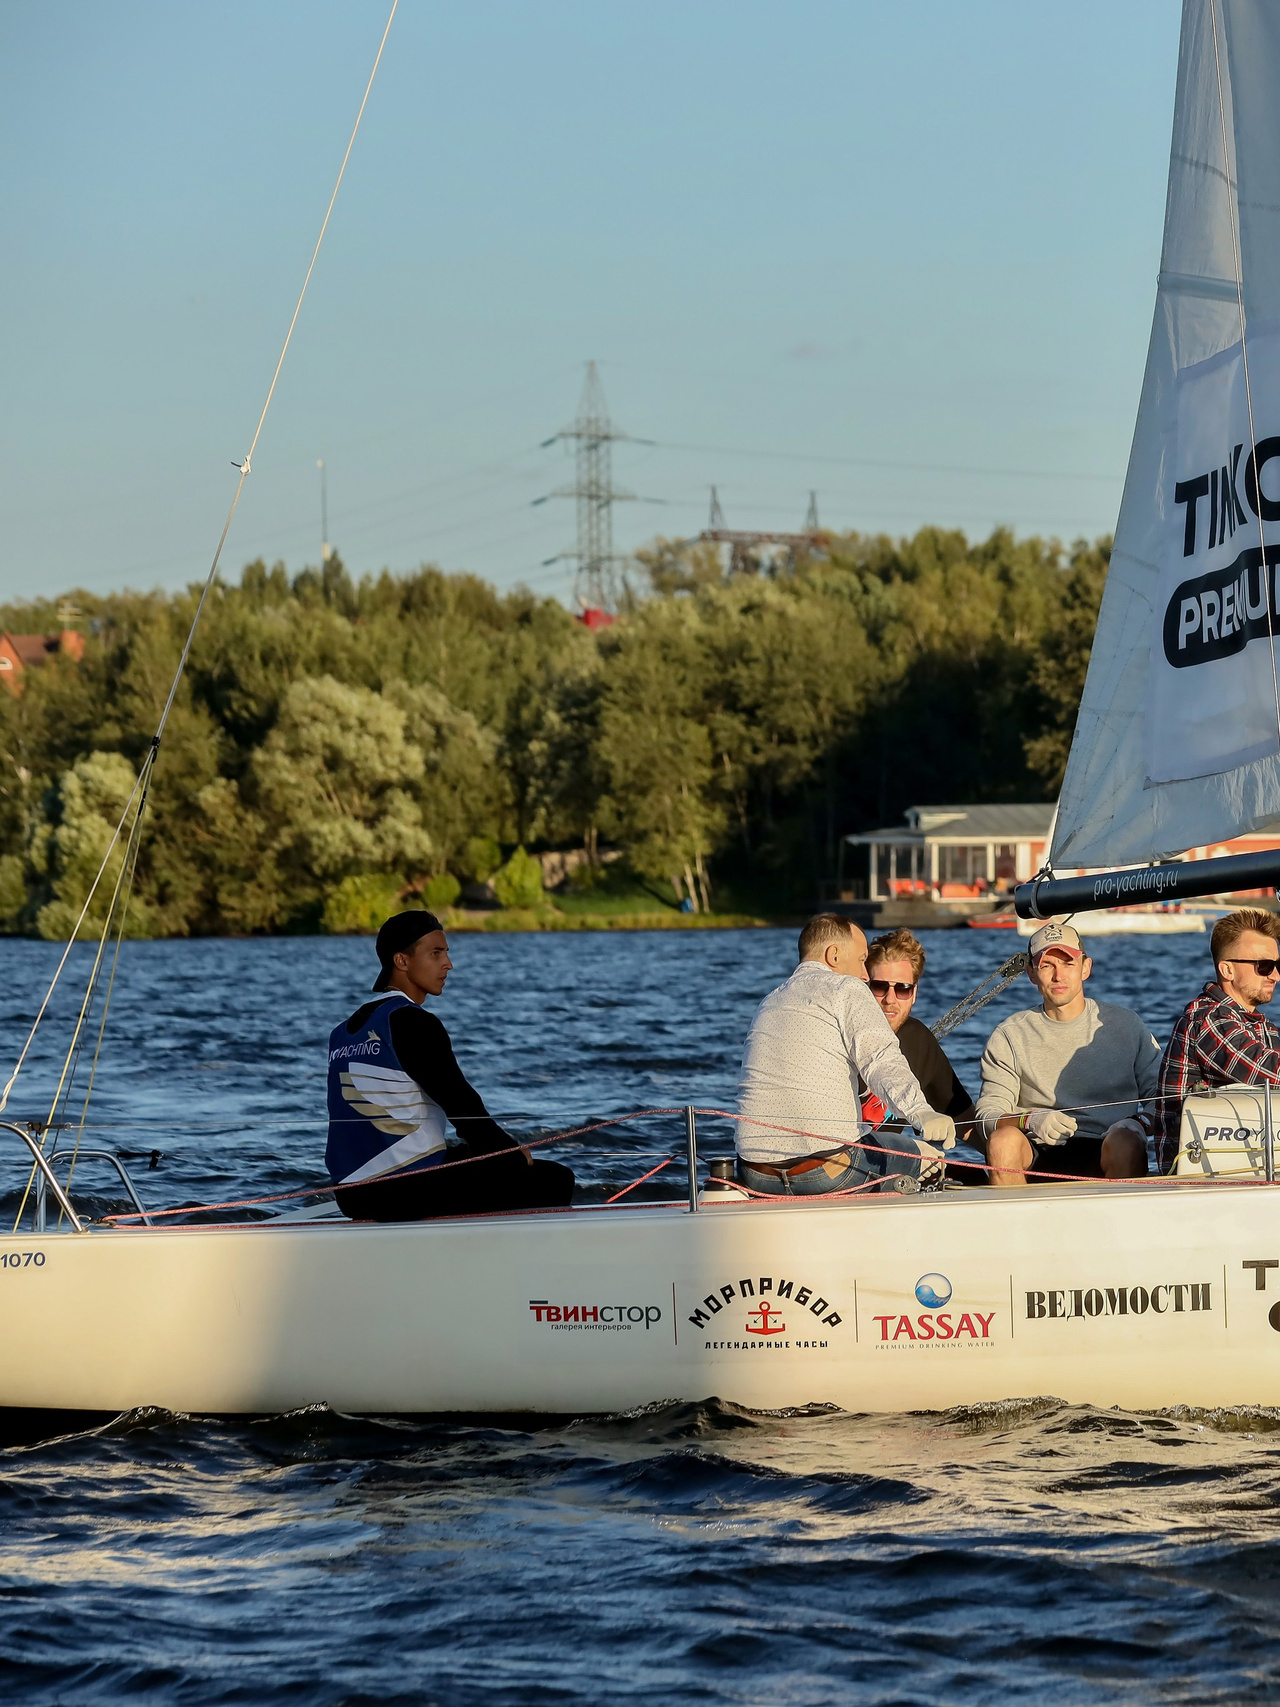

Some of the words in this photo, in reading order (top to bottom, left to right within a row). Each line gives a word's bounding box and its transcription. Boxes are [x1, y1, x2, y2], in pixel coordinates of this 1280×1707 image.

[1094, 868, 1179, 901] pro-yachting.ru
[0, 1251, 46, 1268] 1070
[687, 1276, 844, 1330] МОРПРИБОР
[1024, 1282, 1213, 1322] ВЕДОМОСТИ
[551, 1323, 583, 1332] галерея
[584, 1323, 632, 1332] интерьеров
[872, 1311, 996, 1342] TASSAY
[704, 1341, 790, 1350] ЛЕГЕНДАРНЫЕ
[795, 1340, 828, 1349] ЧАСЫ
[919, 1341, 963, 1349] DRINKING
[967, 1340, 996, 1348] WATER
